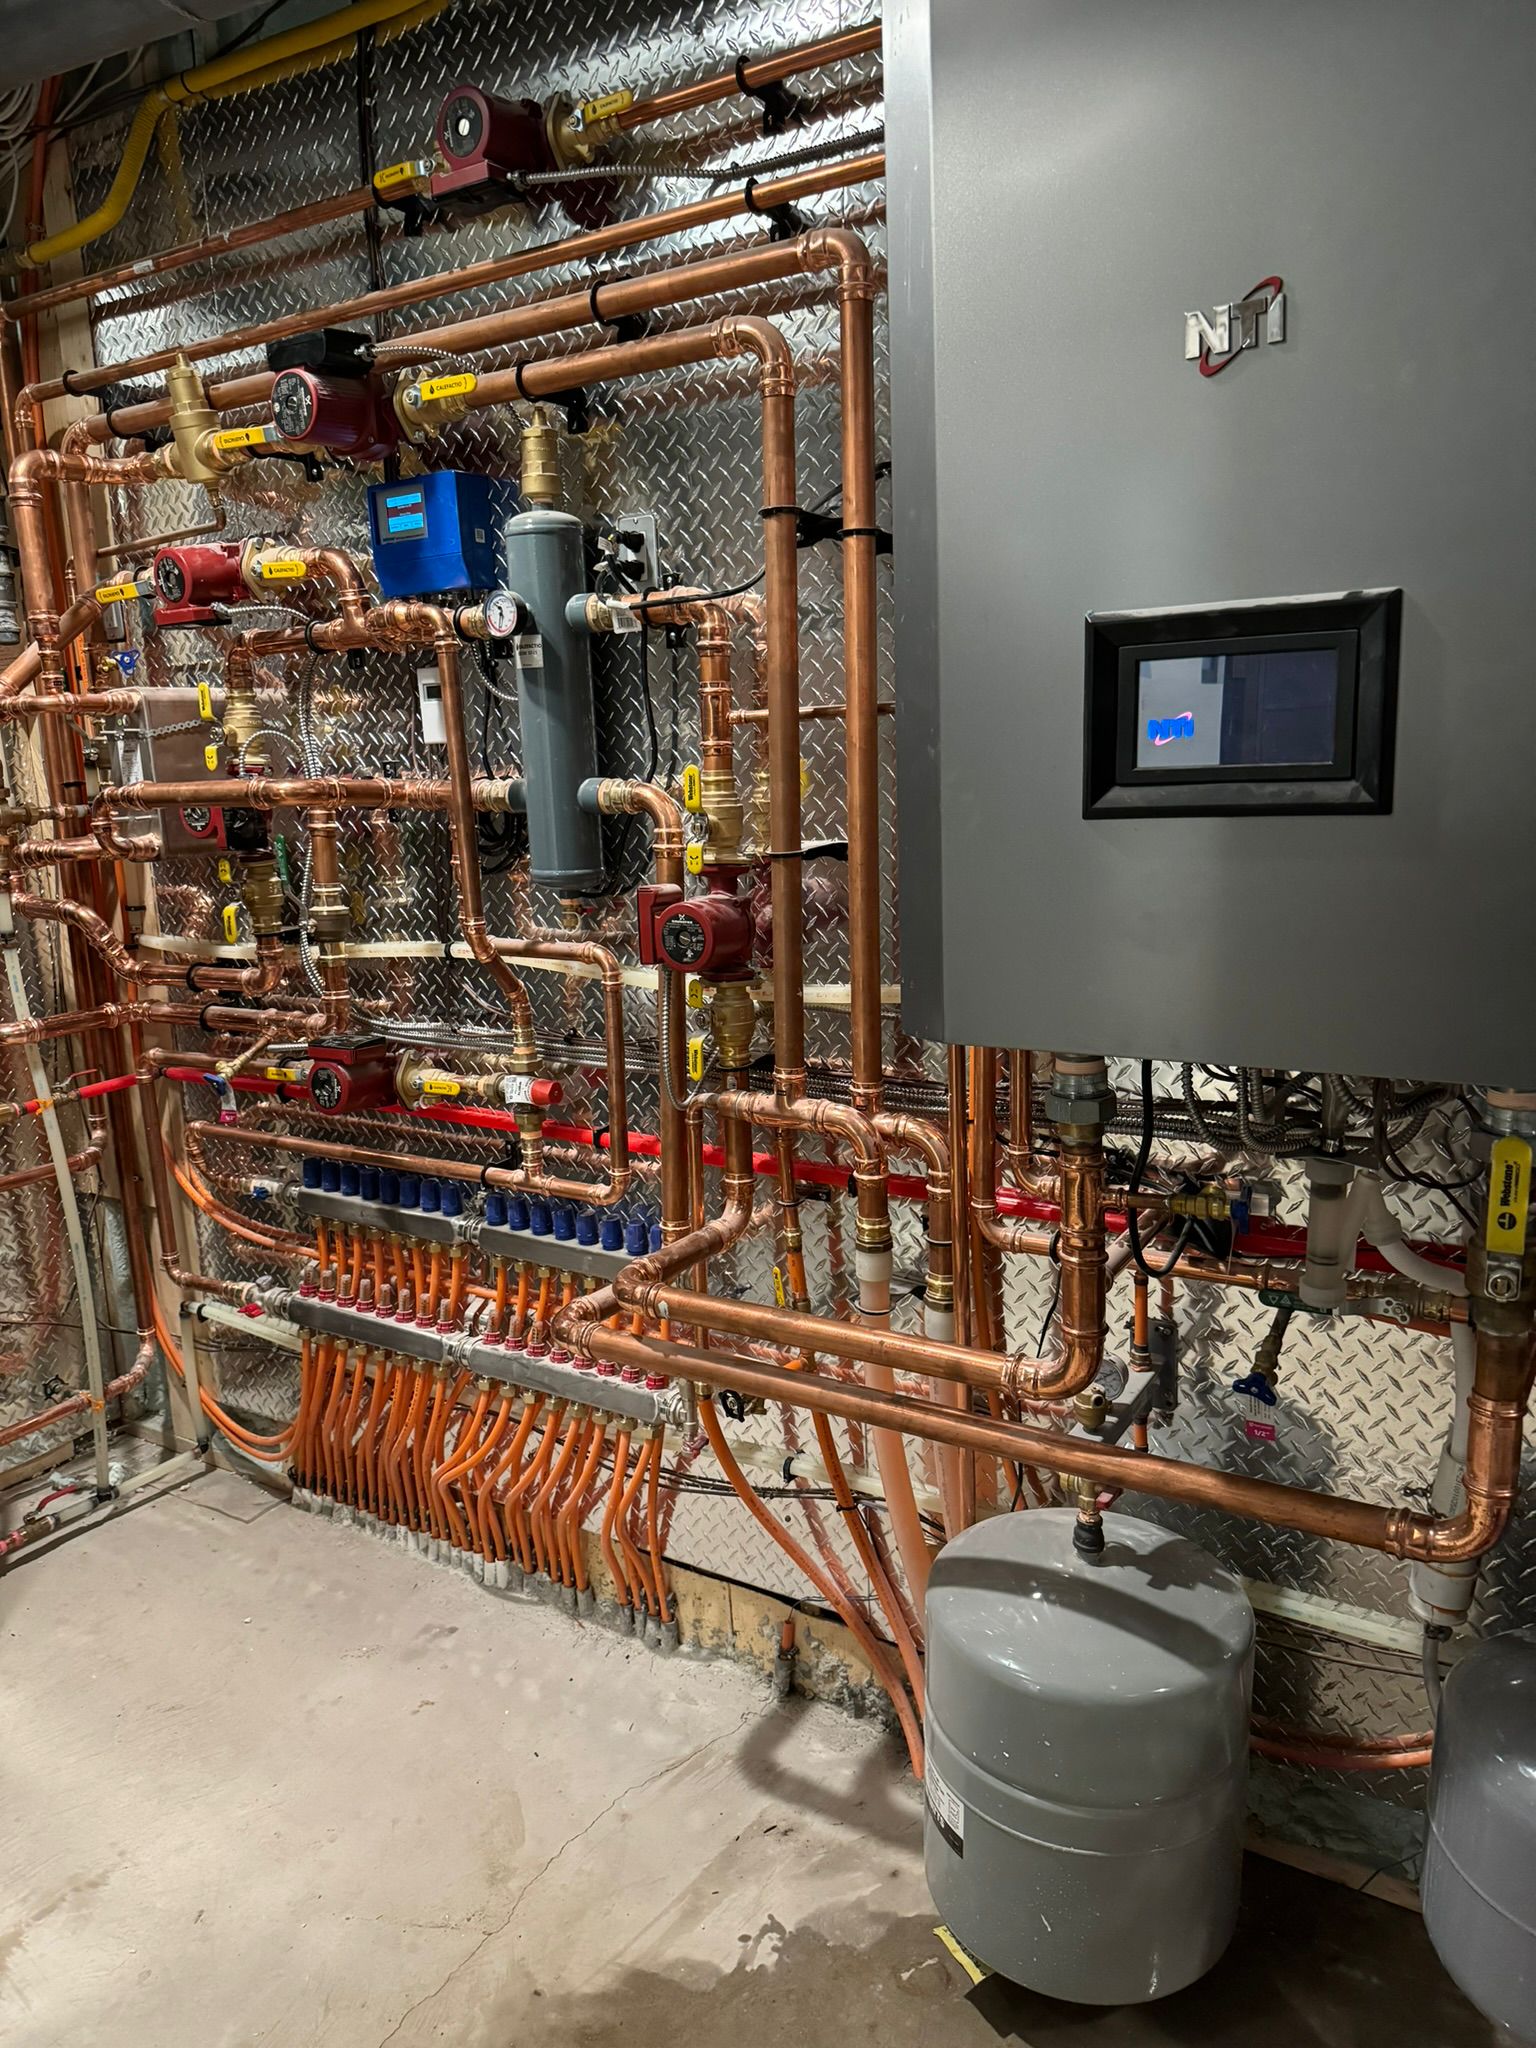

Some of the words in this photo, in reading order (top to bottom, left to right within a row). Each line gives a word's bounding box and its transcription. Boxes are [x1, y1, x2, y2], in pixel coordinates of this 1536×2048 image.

[1184, 292, 1285, 360] NTI
[435, 381, 463, 392] CALEFACTIO
[1147, 719, 1194, 739] NTI
[1500, 1163, 1514, 1207] Webstone
